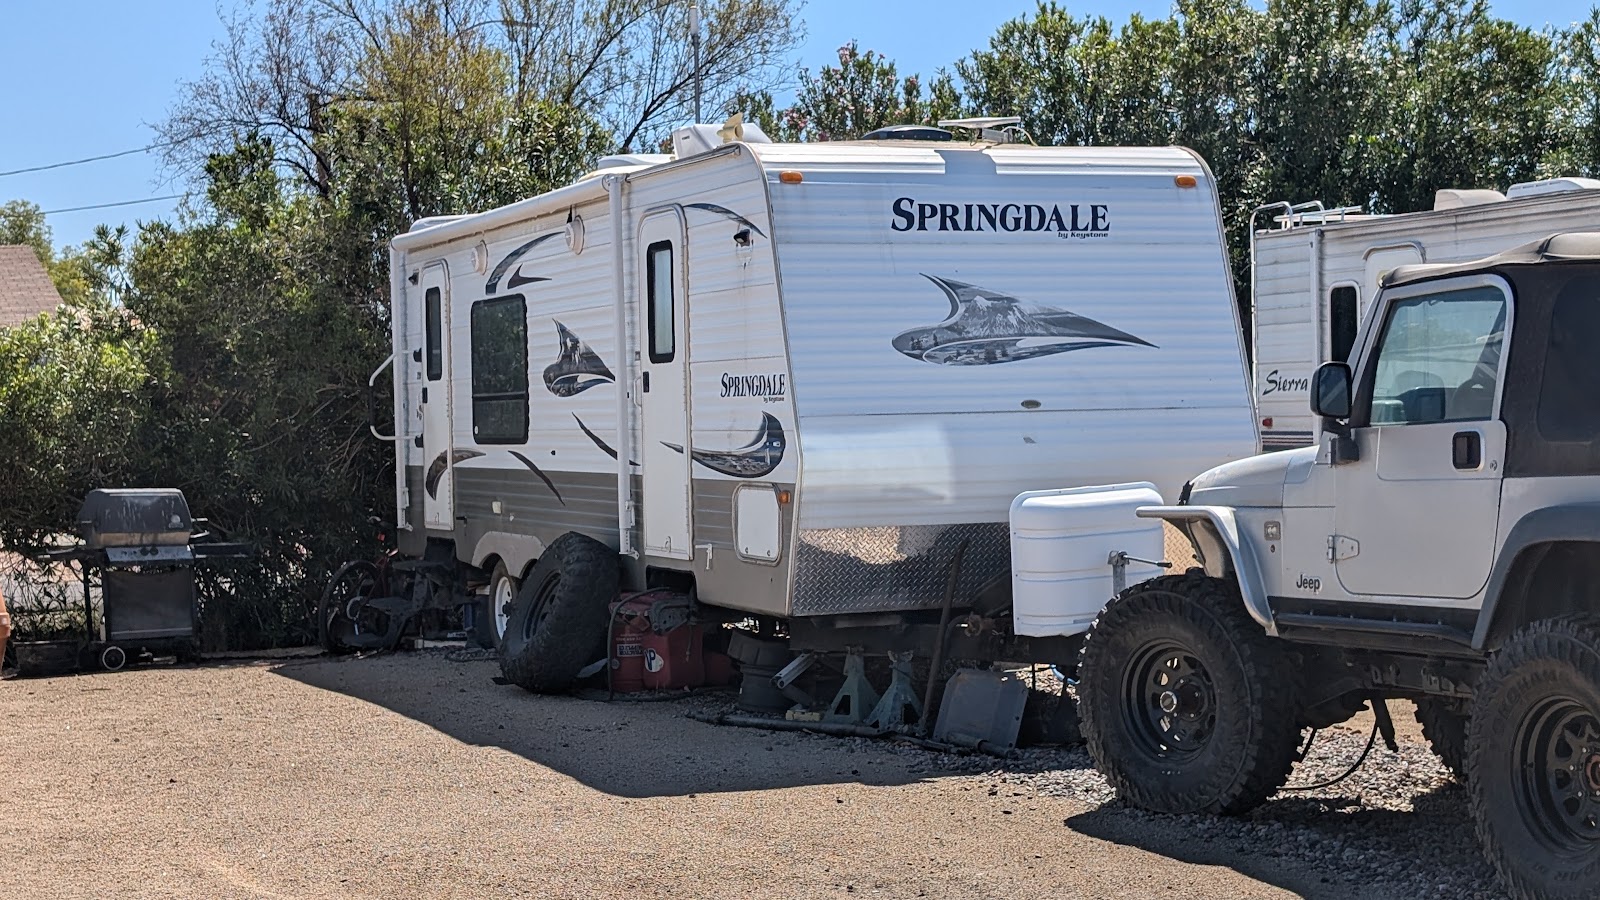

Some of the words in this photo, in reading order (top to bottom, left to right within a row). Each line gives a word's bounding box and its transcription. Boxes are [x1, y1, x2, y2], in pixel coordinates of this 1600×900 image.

[891, 197, 1111, 232] SPRINGDALE
[720, 372, 785, 397] SPRINGDALE
[1262, 369, 1308, 396] Sierra
[1296, 574, 1321, 592] Jeep
